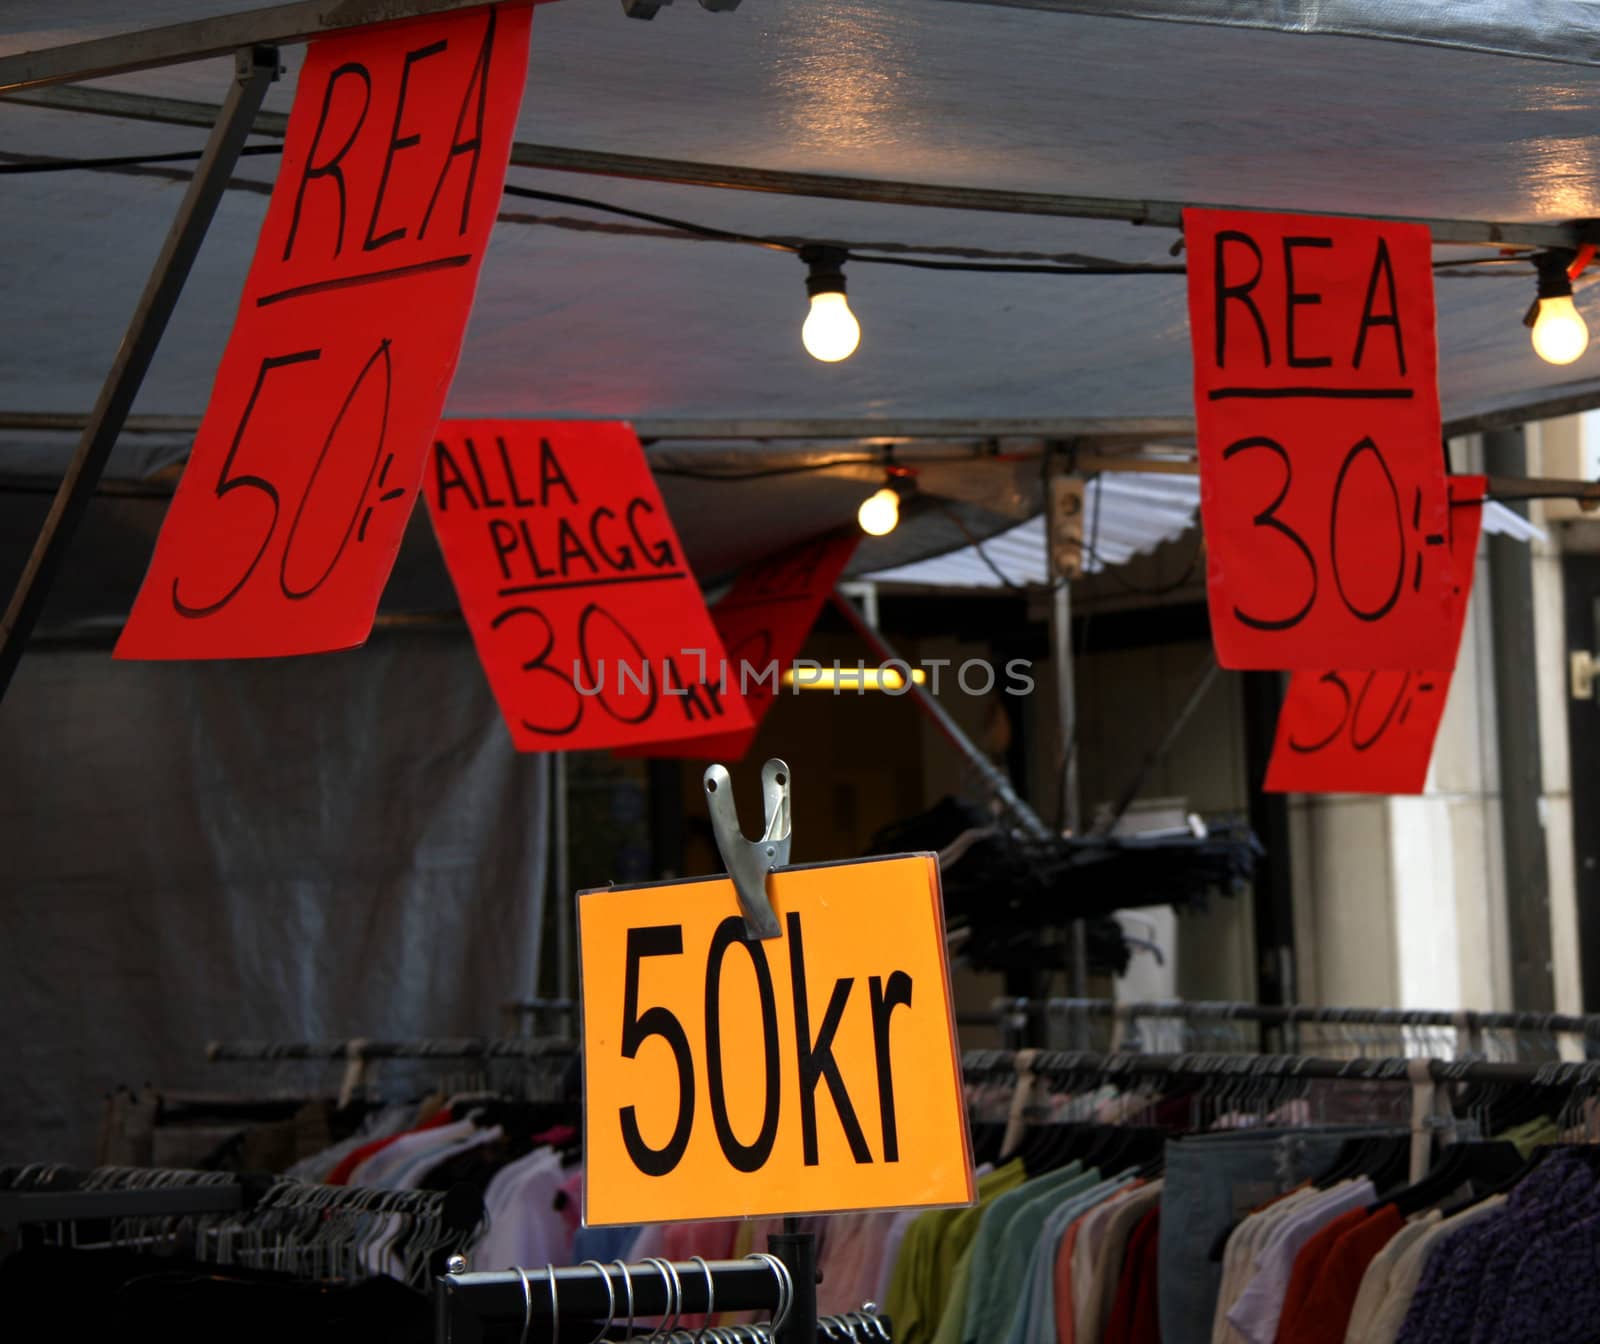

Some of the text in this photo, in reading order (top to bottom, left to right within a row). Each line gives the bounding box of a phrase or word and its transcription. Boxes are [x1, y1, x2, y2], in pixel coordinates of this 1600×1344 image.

[283, 8, 497, 262] REA
[1214, 230, 1407, 377] REA
[171, 338, 405, 618] 50:-
[435, 437, 578, 511] ALLA
[488, 498, 676, 580] PLAGG
[1223, 435, 1445, 632] 30:-
[490, 602, 658, 736] 30
[619, 911, 913, 1177] 50kr
